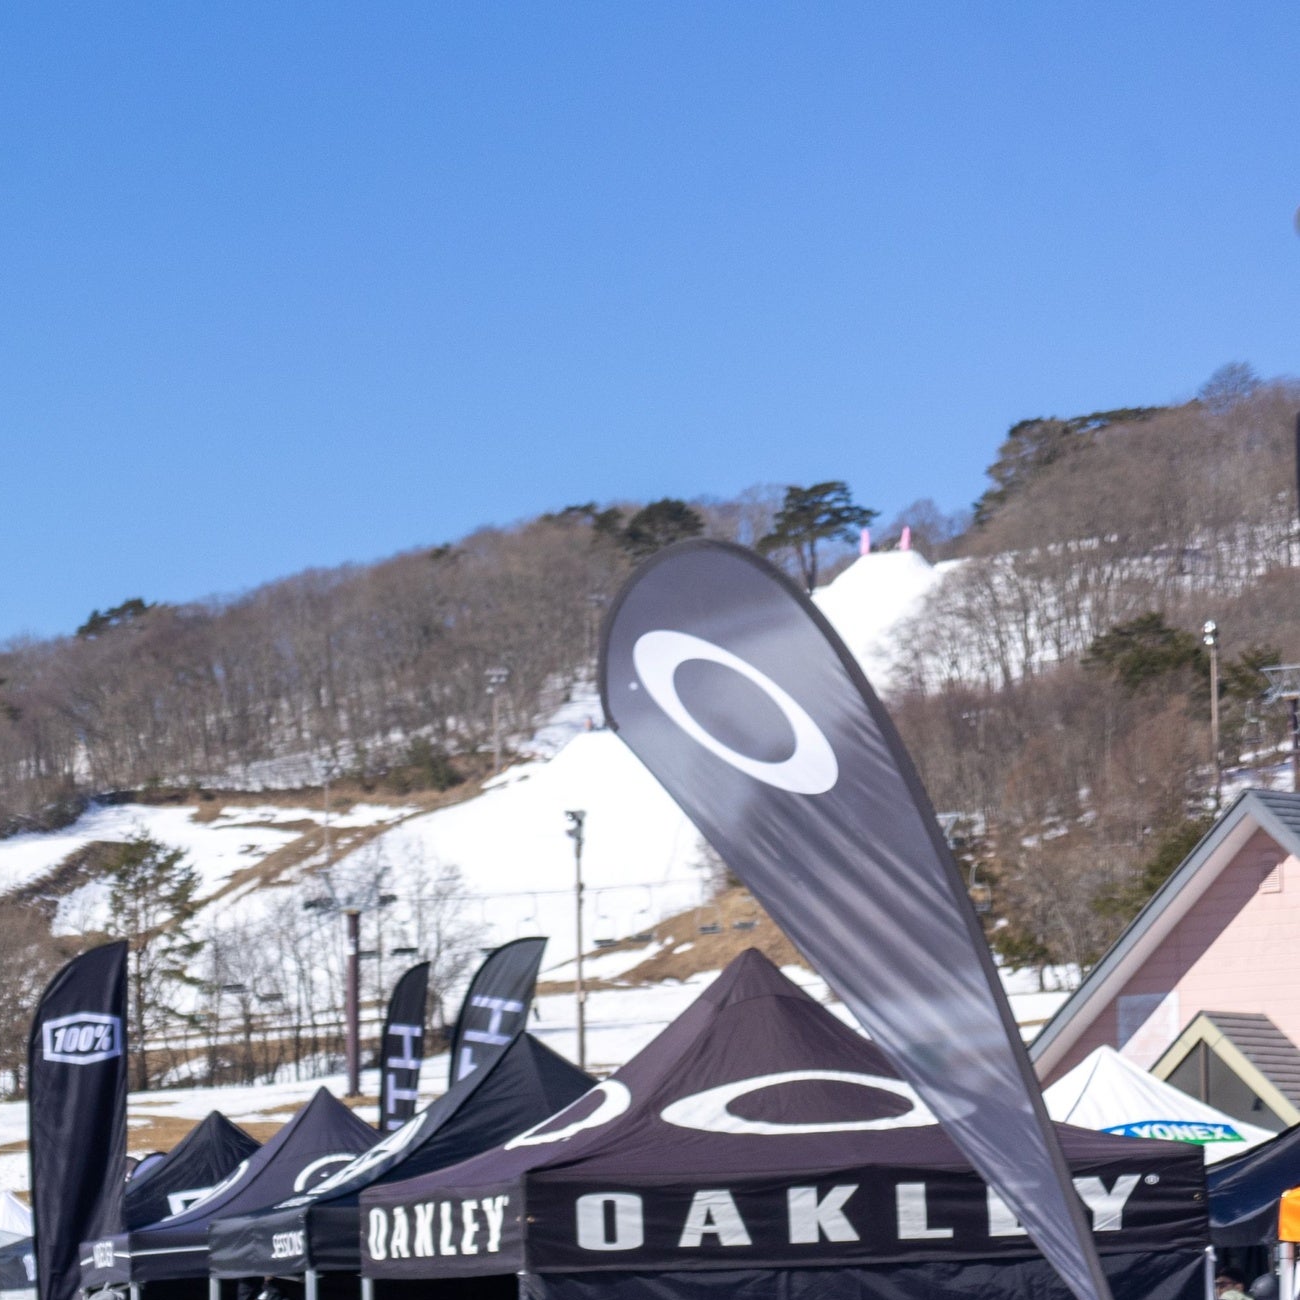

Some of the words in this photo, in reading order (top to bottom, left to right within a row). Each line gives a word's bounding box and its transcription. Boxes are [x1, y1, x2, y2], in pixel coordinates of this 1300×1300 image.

[53, 1024, 112, 1053] 100%
[1131, 1123, 1234, 1141] YONEX
[368, 1195, 506, 1261] OAKLEY
